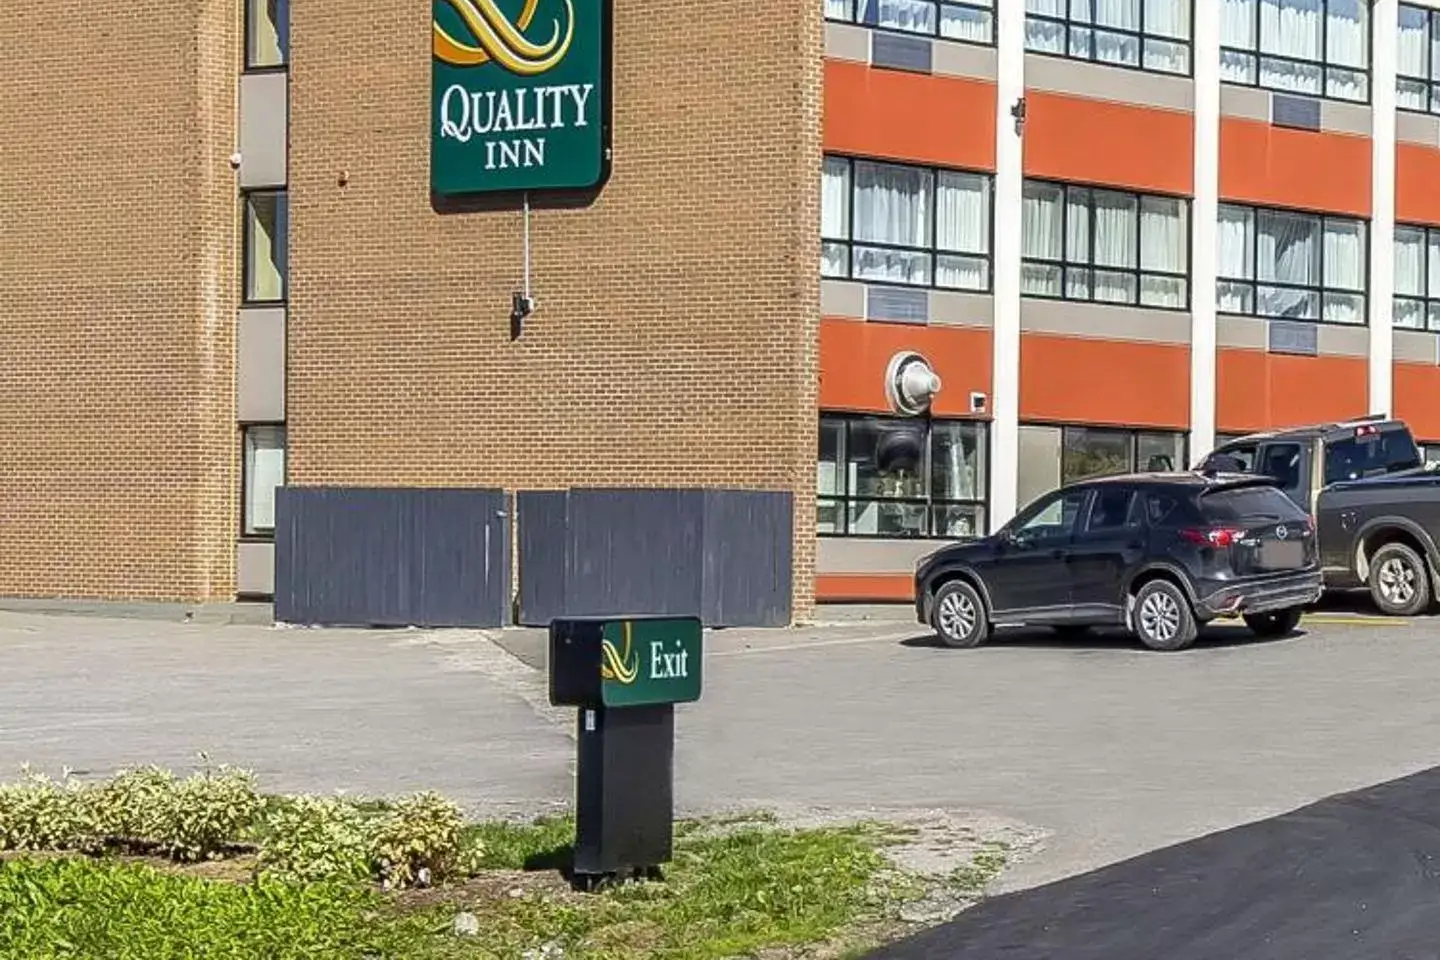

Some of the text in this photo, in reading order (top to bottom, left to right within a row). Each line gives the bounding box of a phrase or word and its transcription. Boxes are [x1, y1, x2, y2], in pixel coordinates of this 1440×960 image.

[441, 83, 593, 142] QUALITY
[485, 138, 545, 169] INN
[650, 639, 688, 679] Exit
